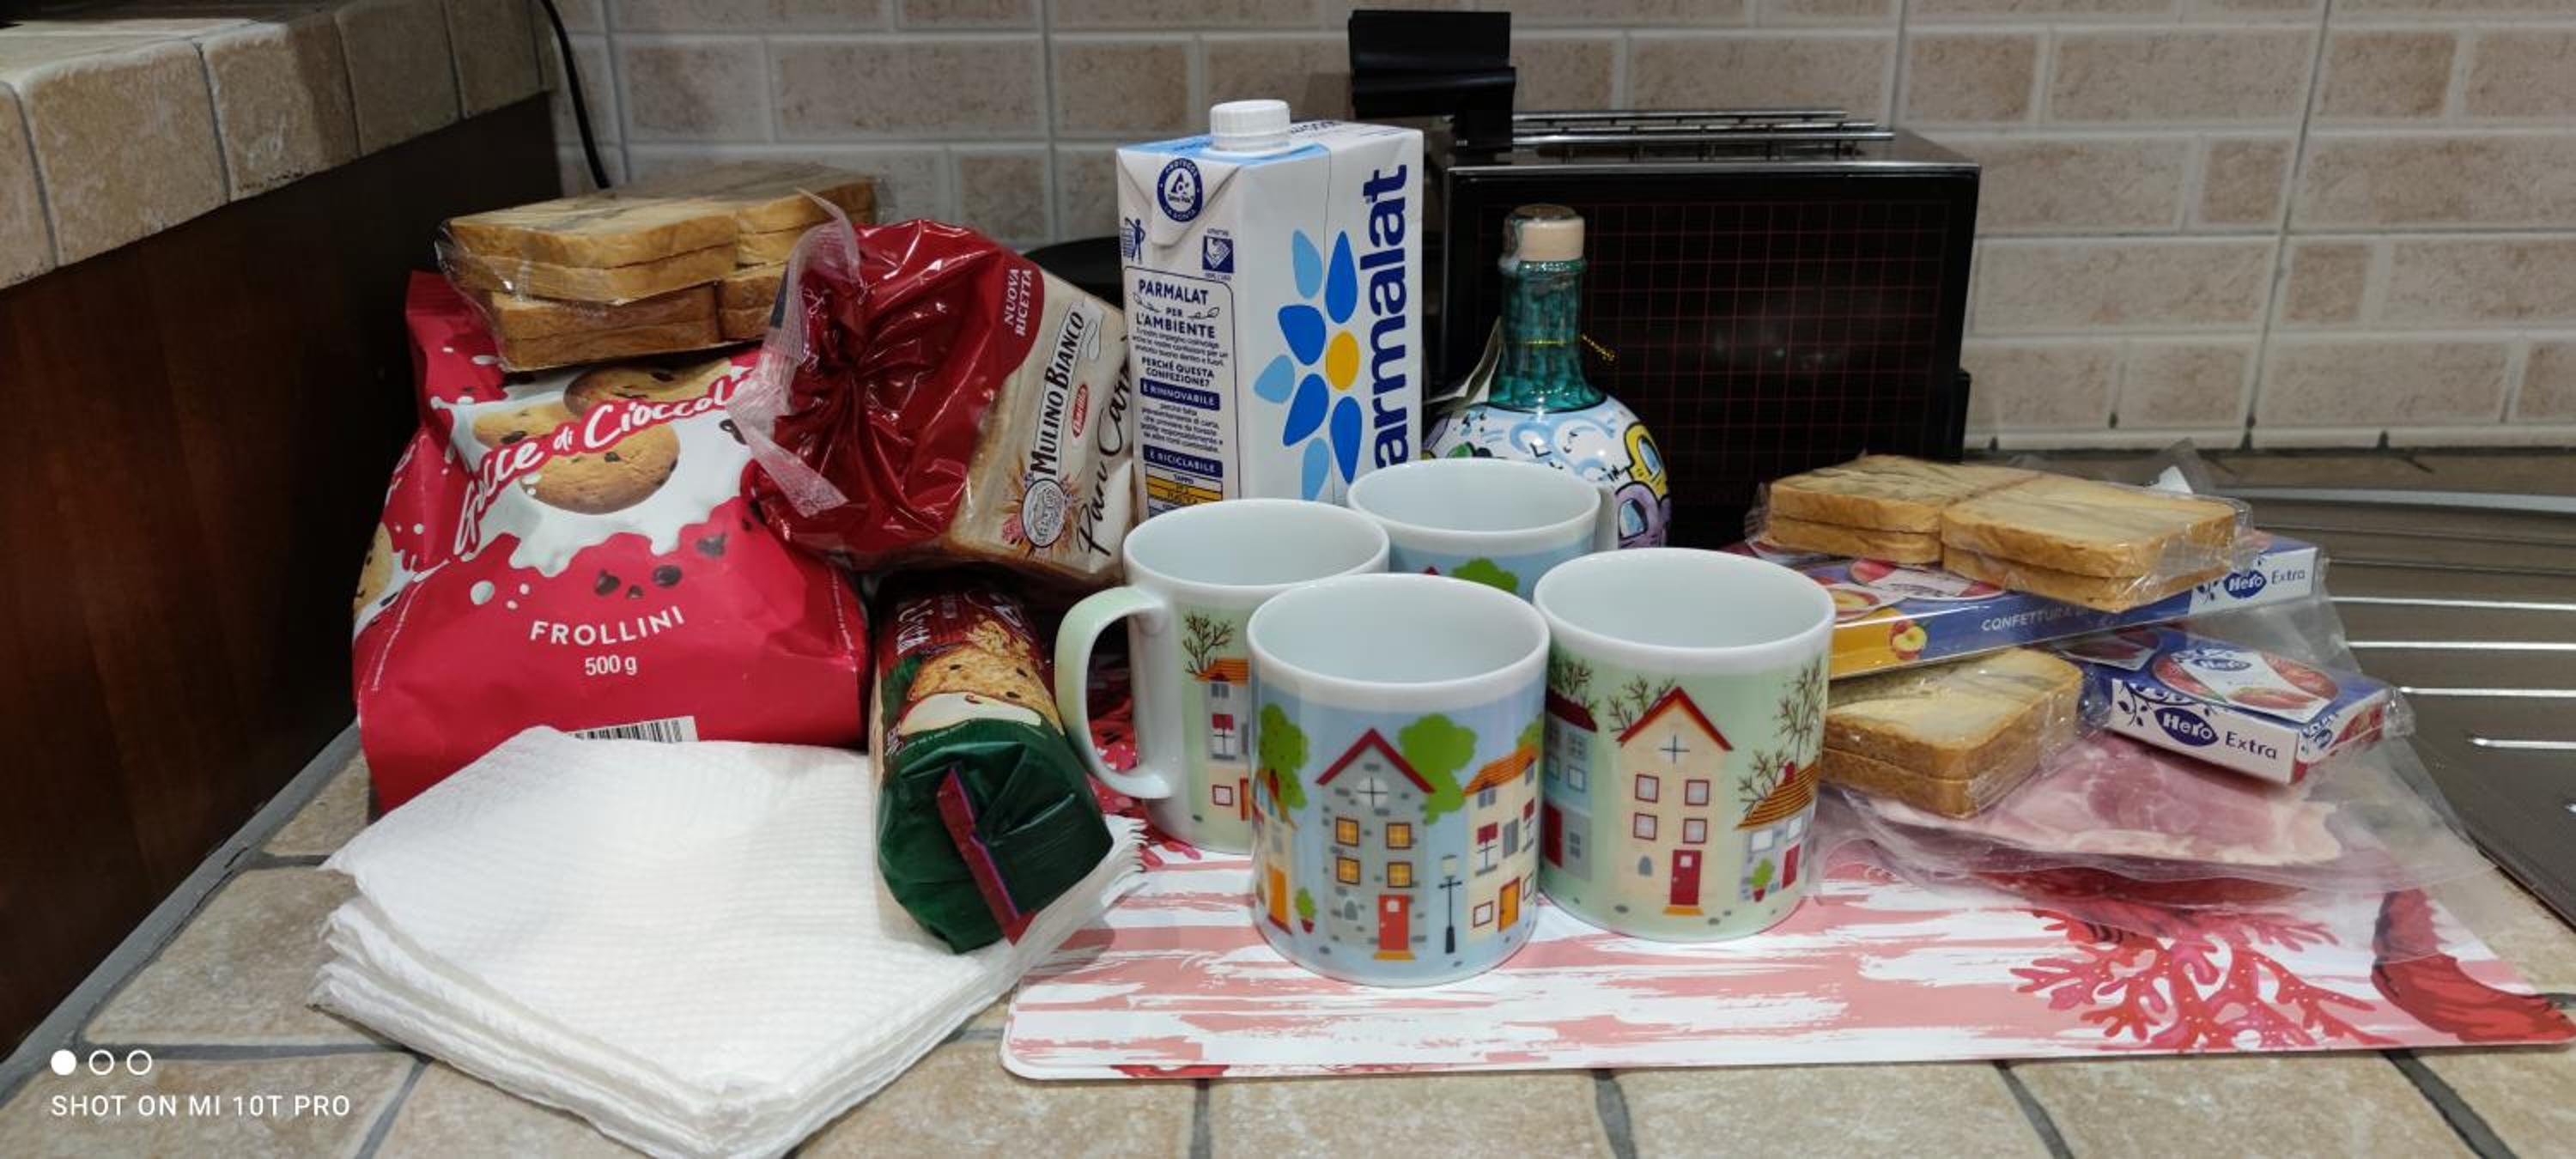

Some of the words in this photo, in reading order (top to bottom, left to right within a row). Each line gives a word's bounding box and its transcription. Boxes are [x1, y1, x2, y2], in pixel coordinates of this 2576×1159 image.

[1004, 270, 1019, 326] NUOVA
[1016, 270, 1032, 337] RICETTA
[1139, 279, 1208, 305] PARMALAT
[1136, 312, 1215, 338] L'AMBIENTE
[1166, 307, 1182, 317] PER
[1360, 164, 1408, 468] armalat
[1141, 356, 1174, 369] PERCHÉ
[1176, 363, 1214, 379] QUESTA
[1146, 367, 1210, 387] CONFEZIONE?
[1150, 386, 1216, 406] RINNOVABILE
[553, 425, 574, 452] di
[1156, 452, 1217, 473] RICICLABILE
[2227, 571, 2266, 592] Hero
[2271, 568, 2306, 586] Extra
[529, 604, 685, 646] FROLLINI
[584, 654, 621, 677] 500
[624, 655, 638, 677] g
[2162, 712, 2213, 741] Hero
[2225, 731, 2278, 760] Extra
